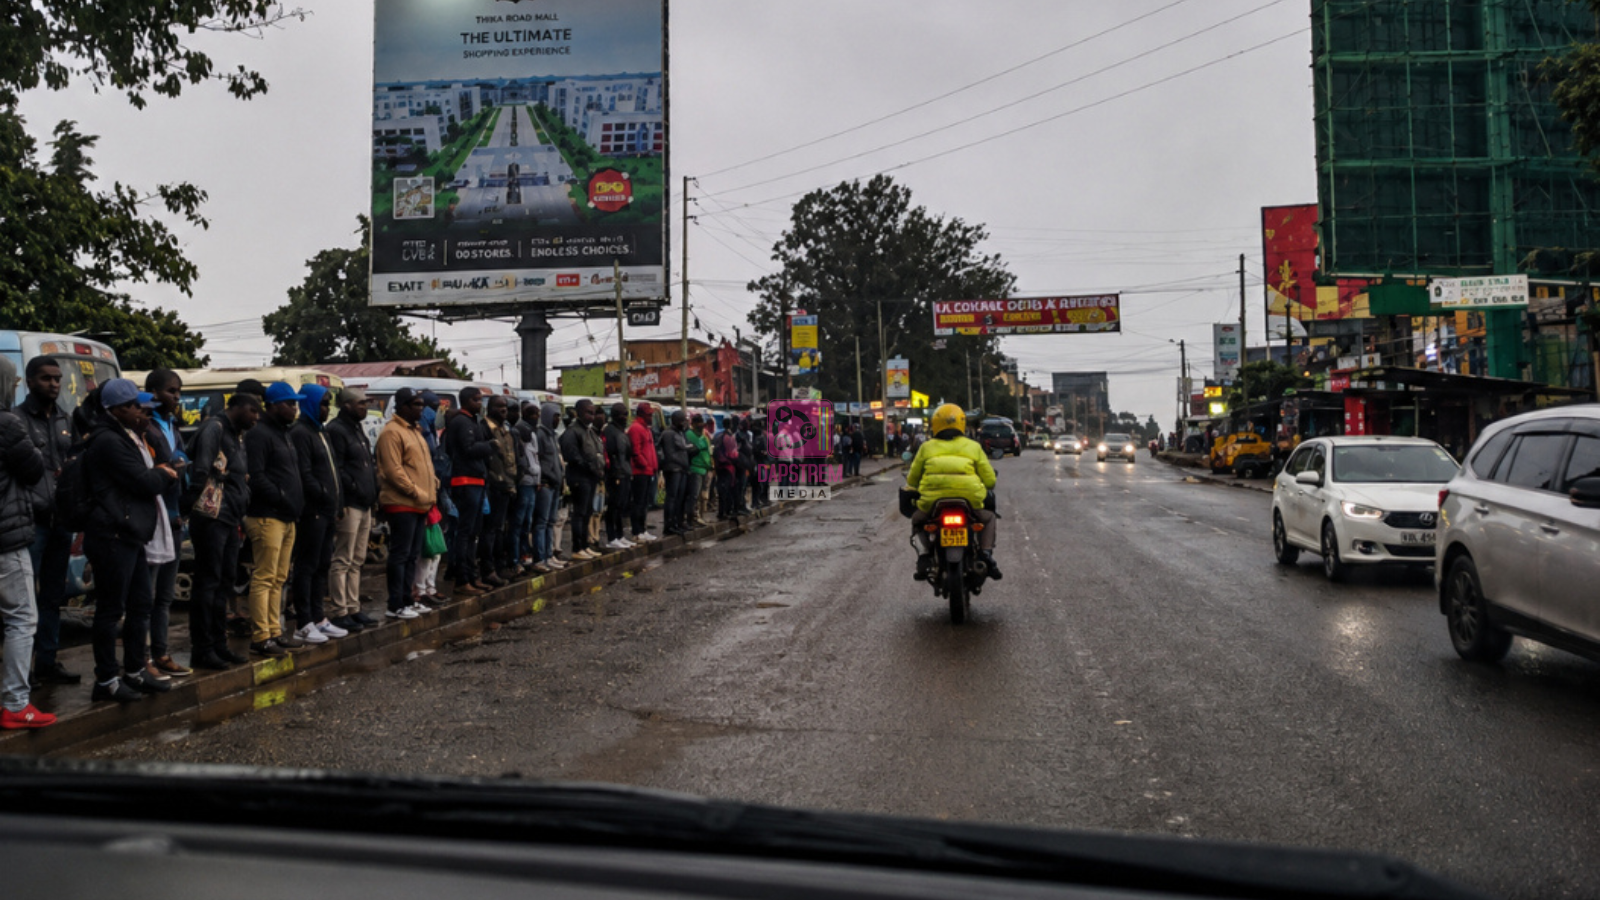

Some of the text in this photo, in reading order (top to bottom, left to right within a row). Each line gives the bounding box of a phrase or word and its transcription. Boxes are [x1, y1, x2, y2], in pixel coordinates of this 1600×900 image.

[475, 13, 559, 24] THIKA ROAD MALL
[460, 28, 572, 44] THE ULTIMATE
[463, 46, 571, 59] SHOPPING EXPERIENCE
